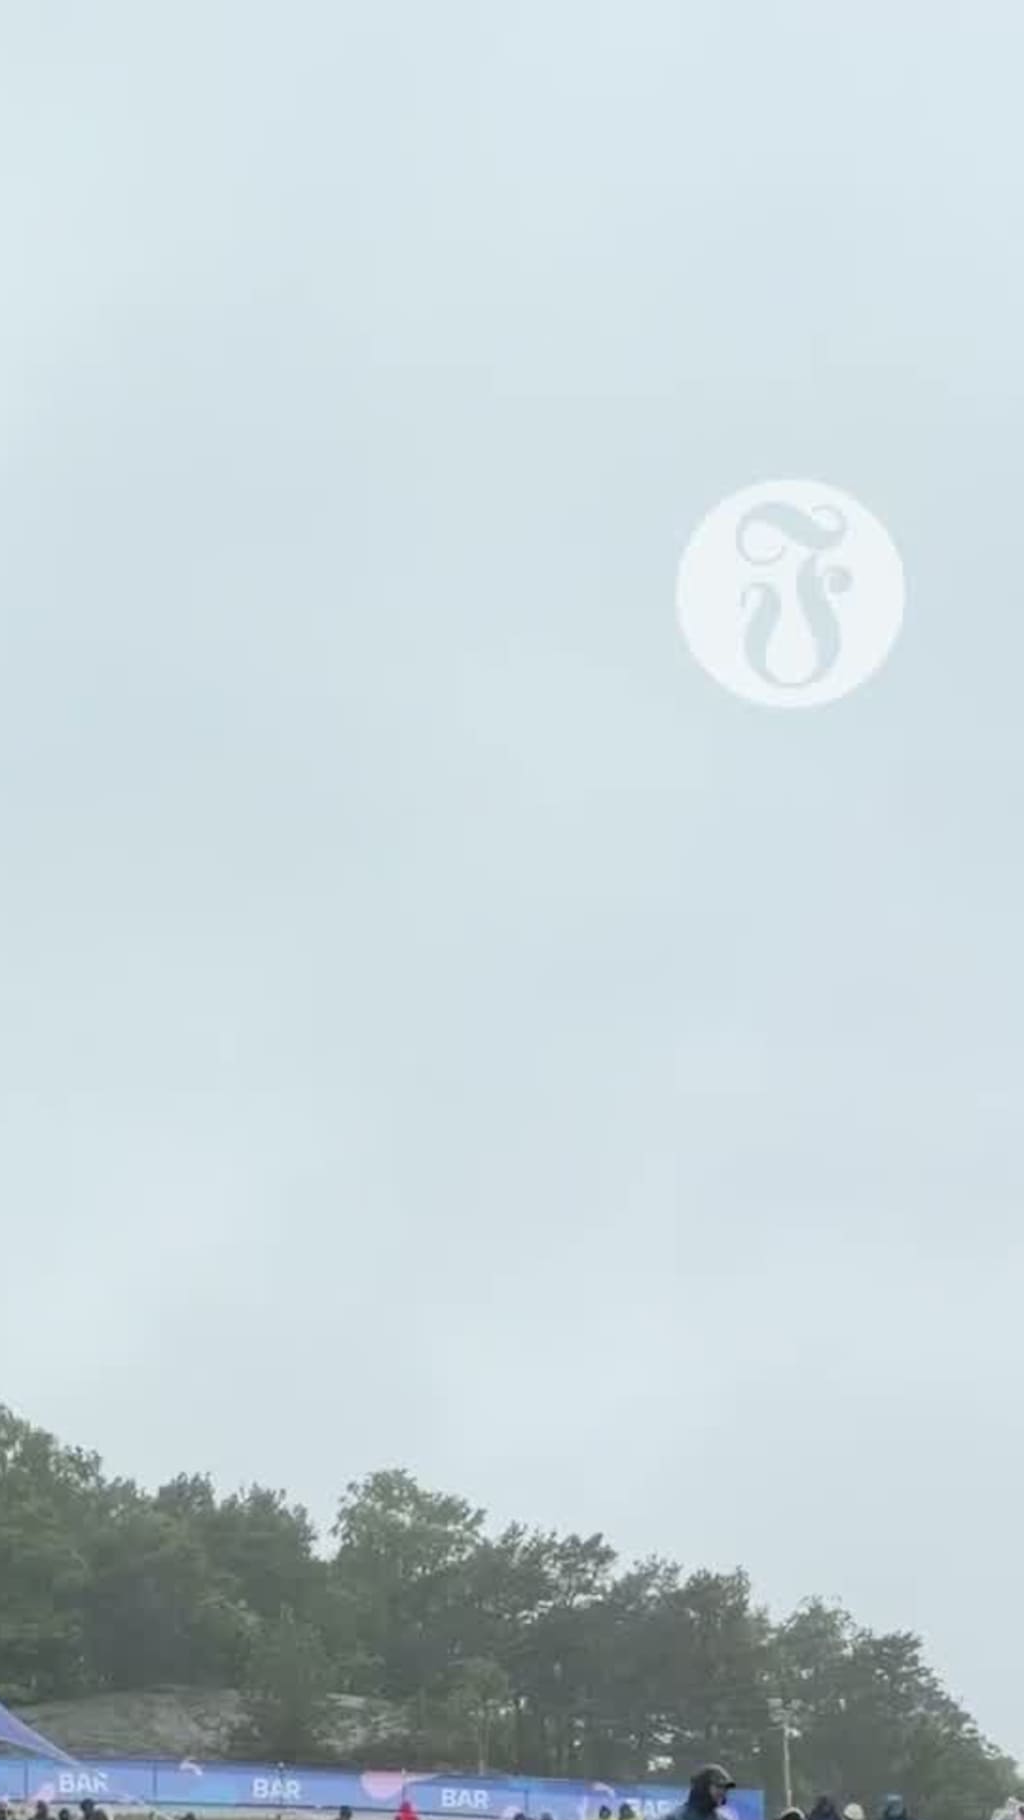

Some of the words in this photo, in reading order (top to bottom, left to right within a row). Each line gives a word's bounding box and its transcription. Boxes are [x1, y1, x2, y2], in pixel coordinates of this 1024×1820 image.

[59, 1772, 109, 1793] BAR
[253, 1777, 301, 1800] BAR
[441, 1787, 490, 1809] BAR
